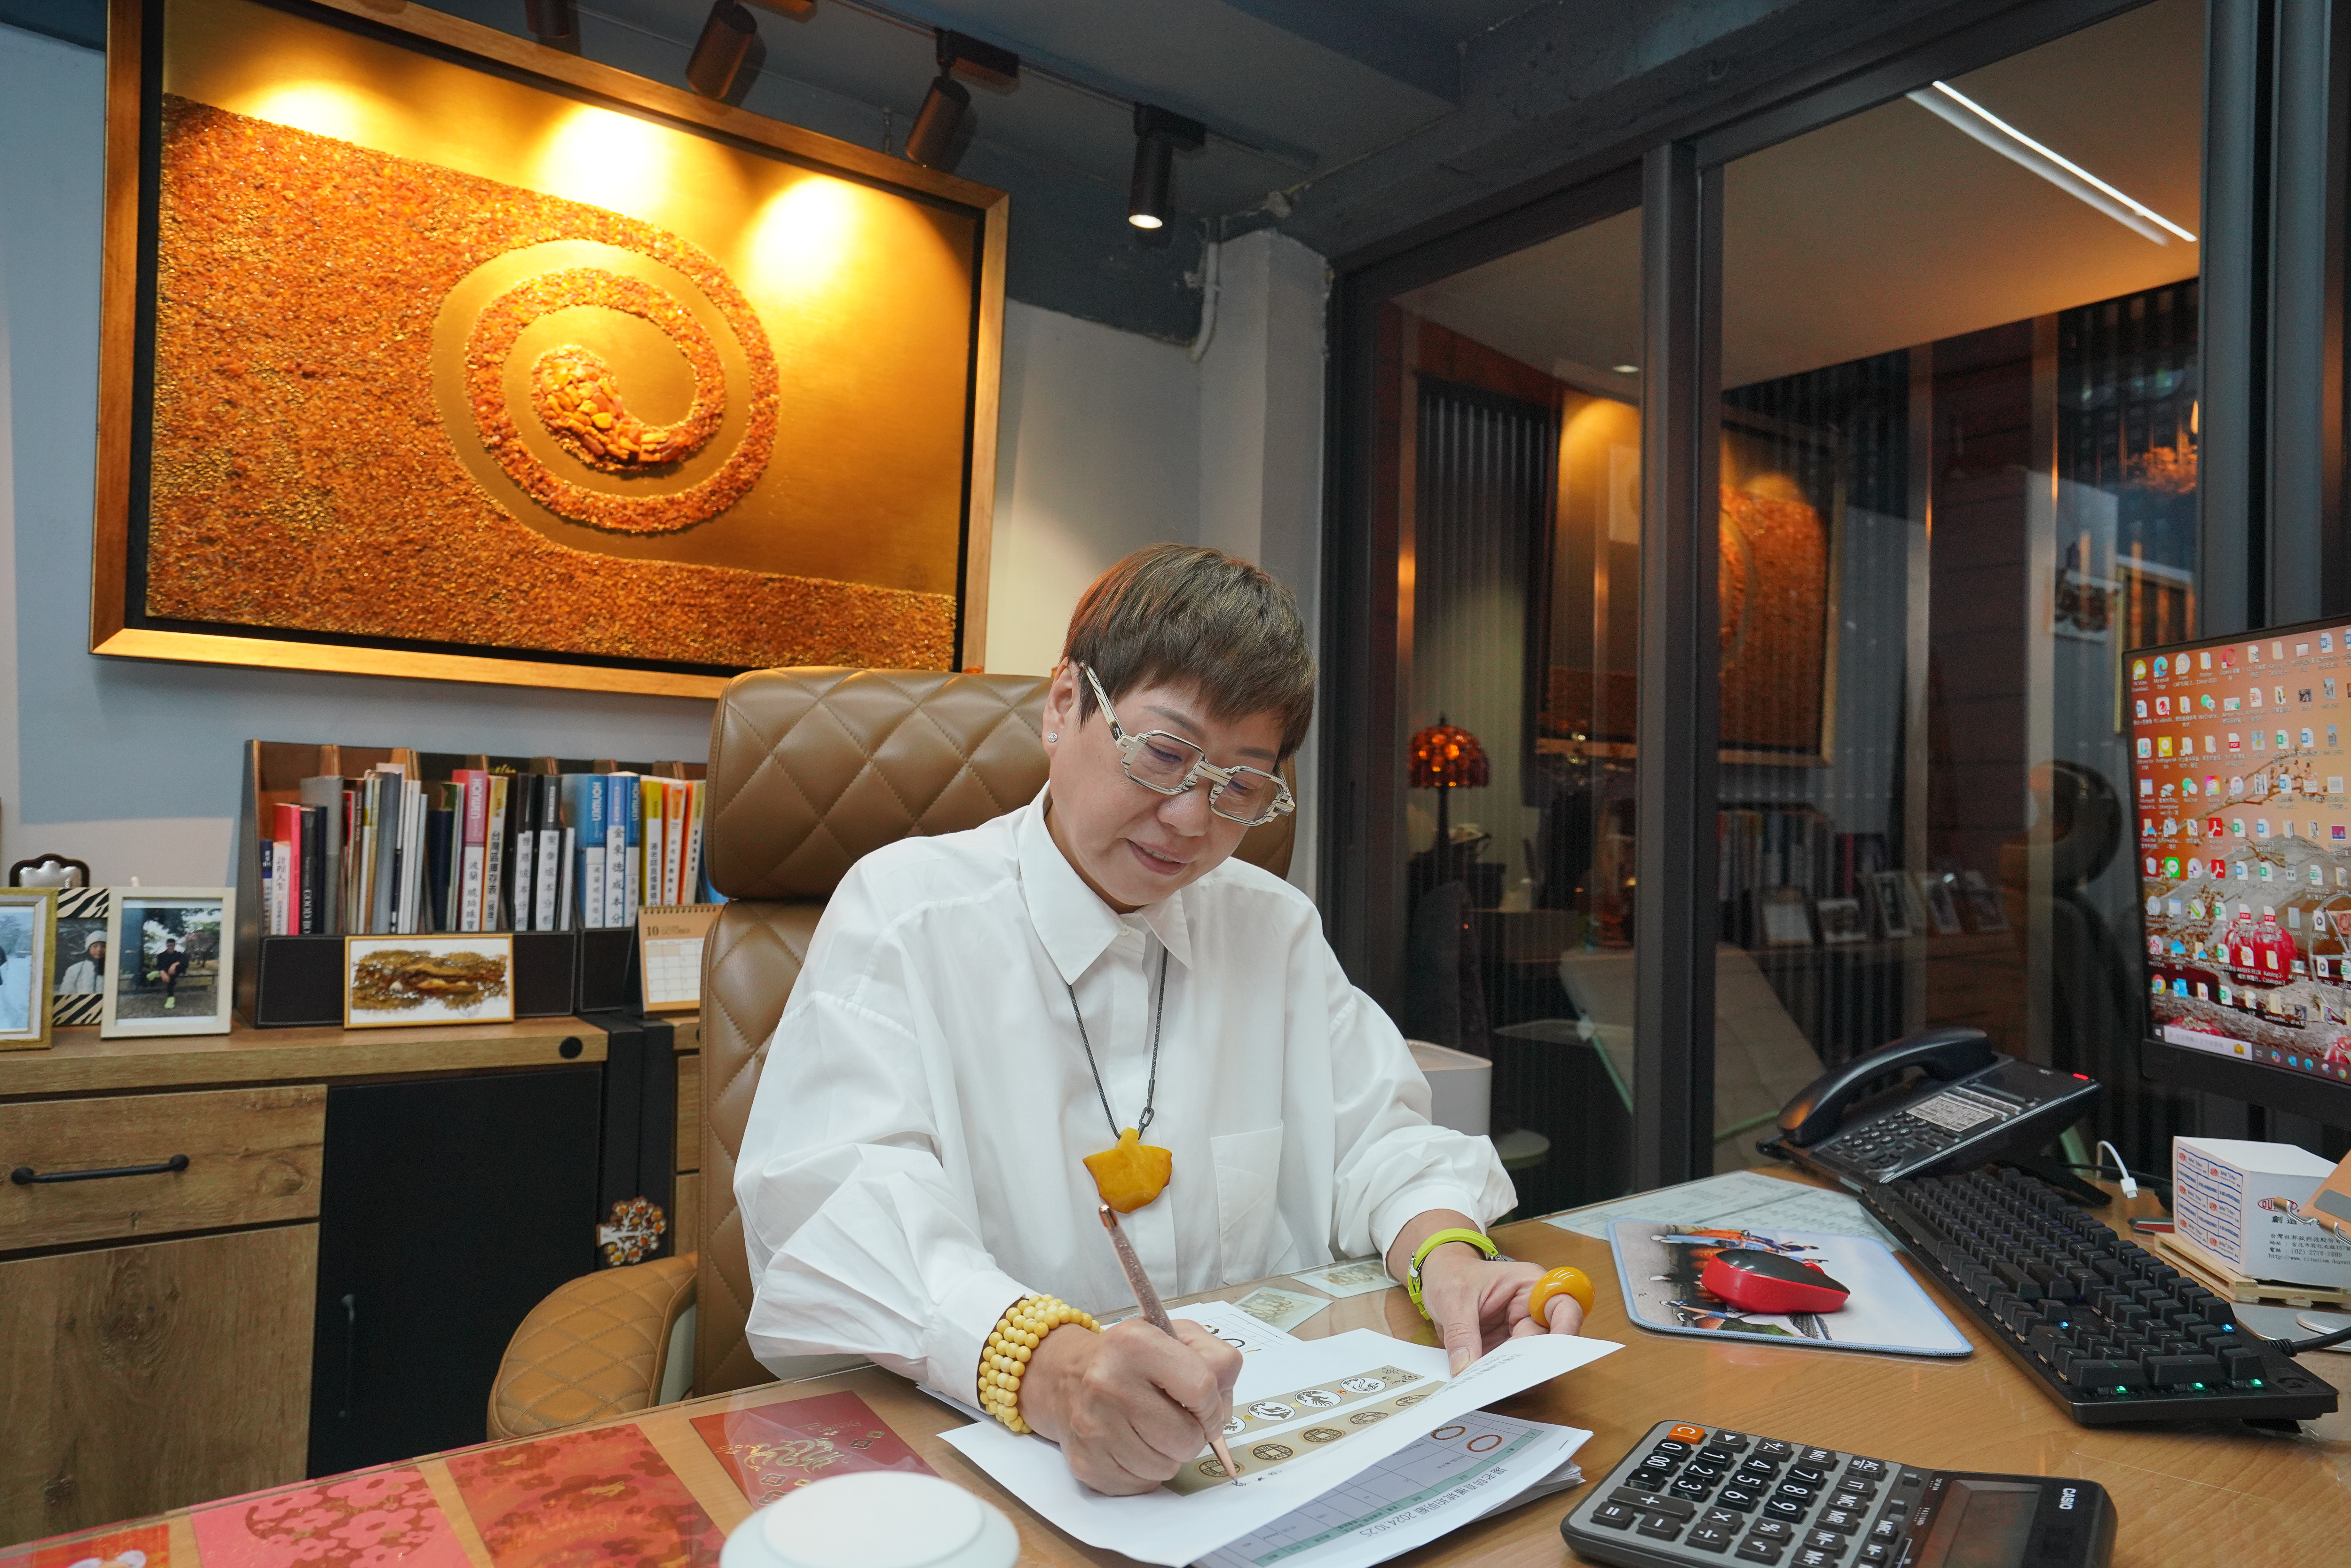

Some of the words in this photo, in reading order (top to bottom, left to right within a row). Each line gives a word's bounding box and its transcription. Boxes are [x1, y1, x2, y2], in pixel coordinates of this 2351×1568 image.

[647, 926, 659, 937] 10
[1647, 1455, 1670, 1467] 00
[1809, 1450, 1827, 1461] MU
[1689, 1465, 1713, 1474] 2
[1748, 1460, 1770, 1469] 4
[1865, 1460, 1879, 1471] AC
[1737, 1474, 1761, 1485] 5
[1794, 1470, 1818, 1480] 7
[1413, 1466, 1507, 1515] 湯老師直播琥珀明細
[1678, 1480, 1702, 1490] 3
[1783, 1485, 1808, 1495] 8
[1725, 1490, 1749, 1500] 6
[1837, 1494, 1857, 1507] MC
[2059, 1487, 2077, 1510] CASIO
[1772, 1501, 1797, 1511] 9
[1826, 1510, 1847, 1524] MR
[1359, 1512, 1416, 1538] 2024.10.25
[1876, 1520, 1893, 1534] MRC
